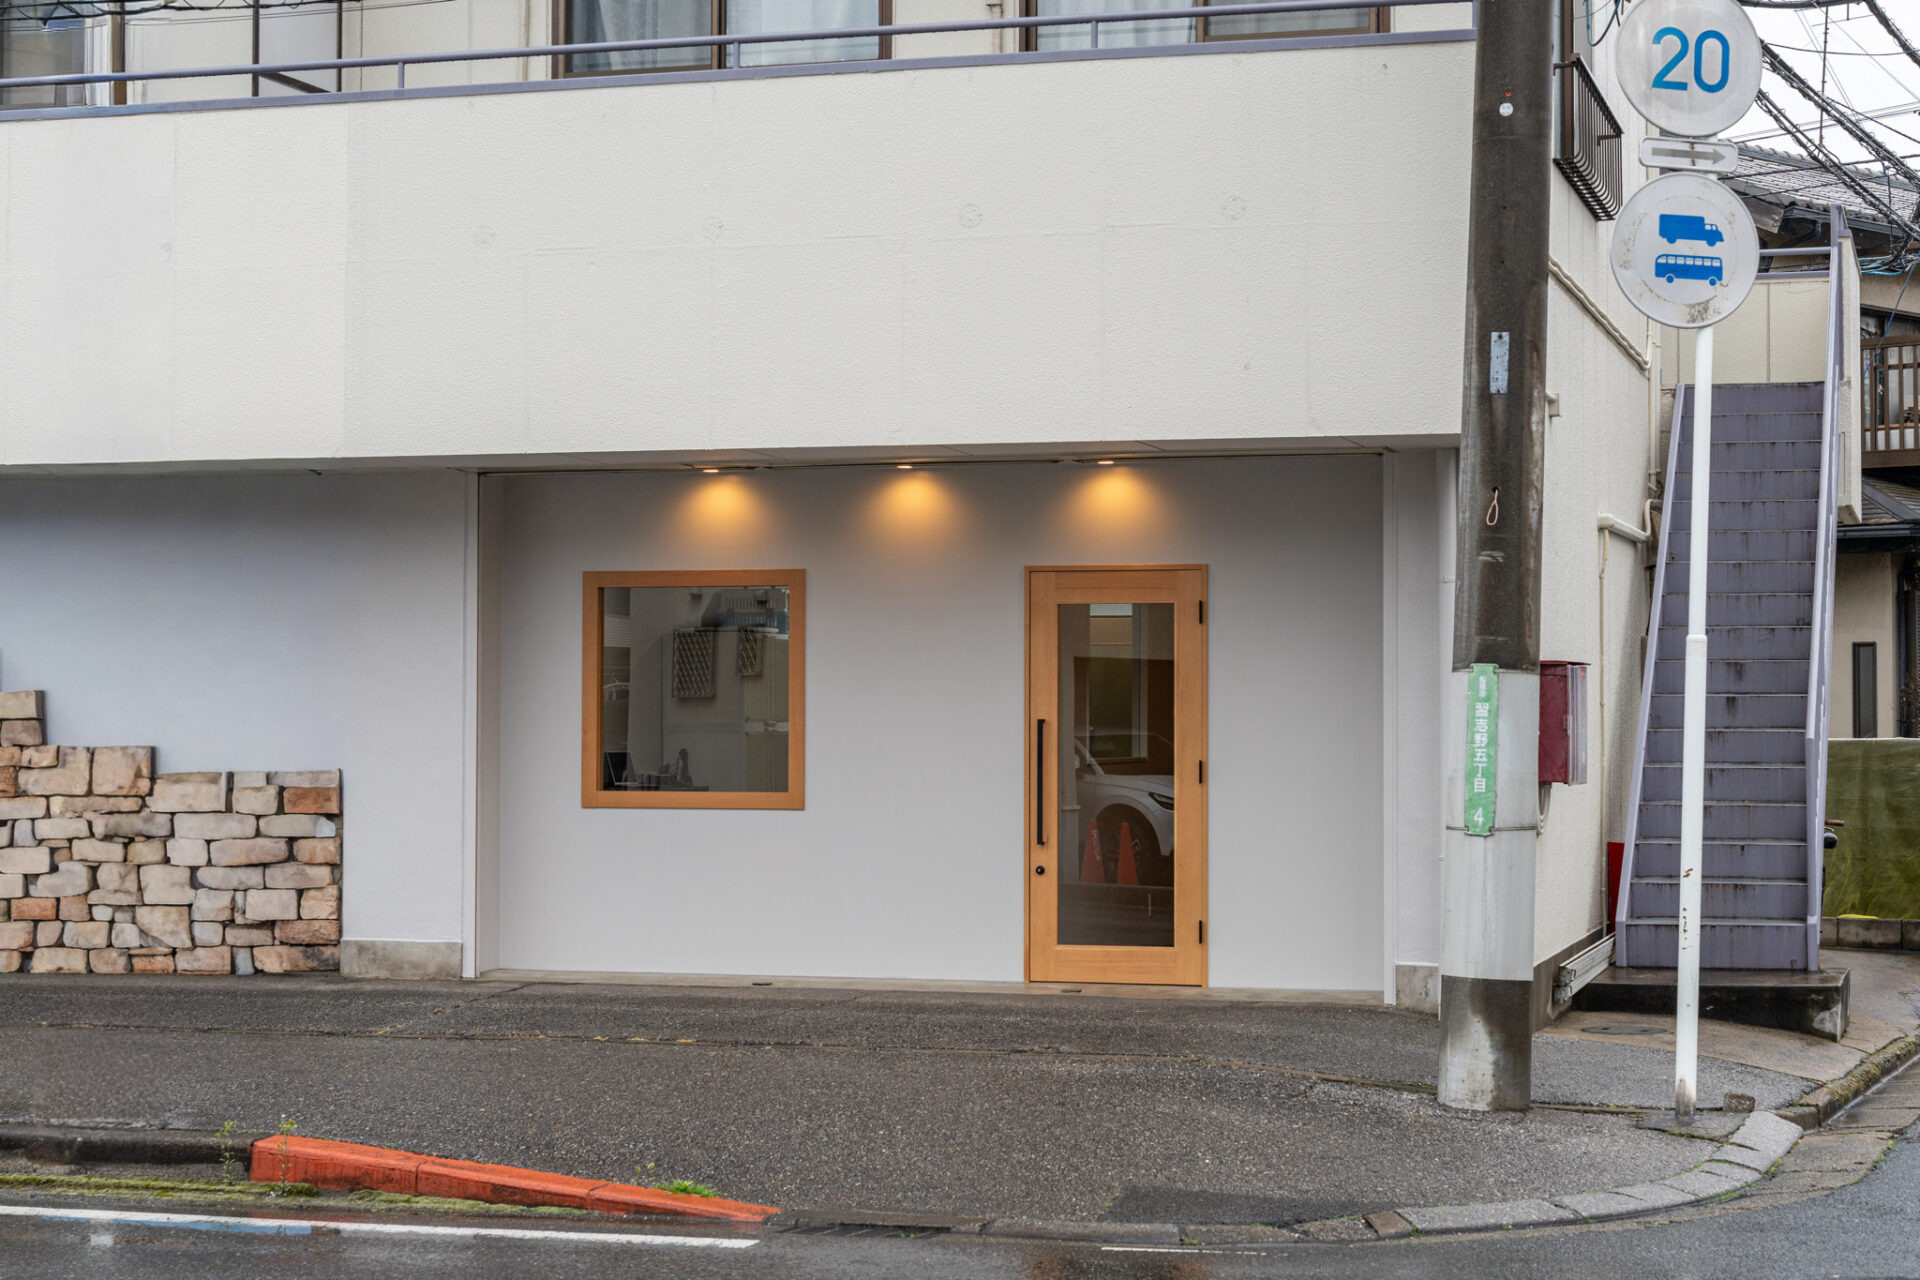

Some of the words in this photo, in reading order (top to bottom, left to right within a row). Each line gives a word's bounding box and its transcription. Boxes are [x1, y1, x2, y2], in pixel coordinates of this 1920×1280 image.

[1652, 27, 1730, 93] 20
[1473, 702, 1489, 793] 習志野五丁目
[1473, 807, 1485, 824] 4
